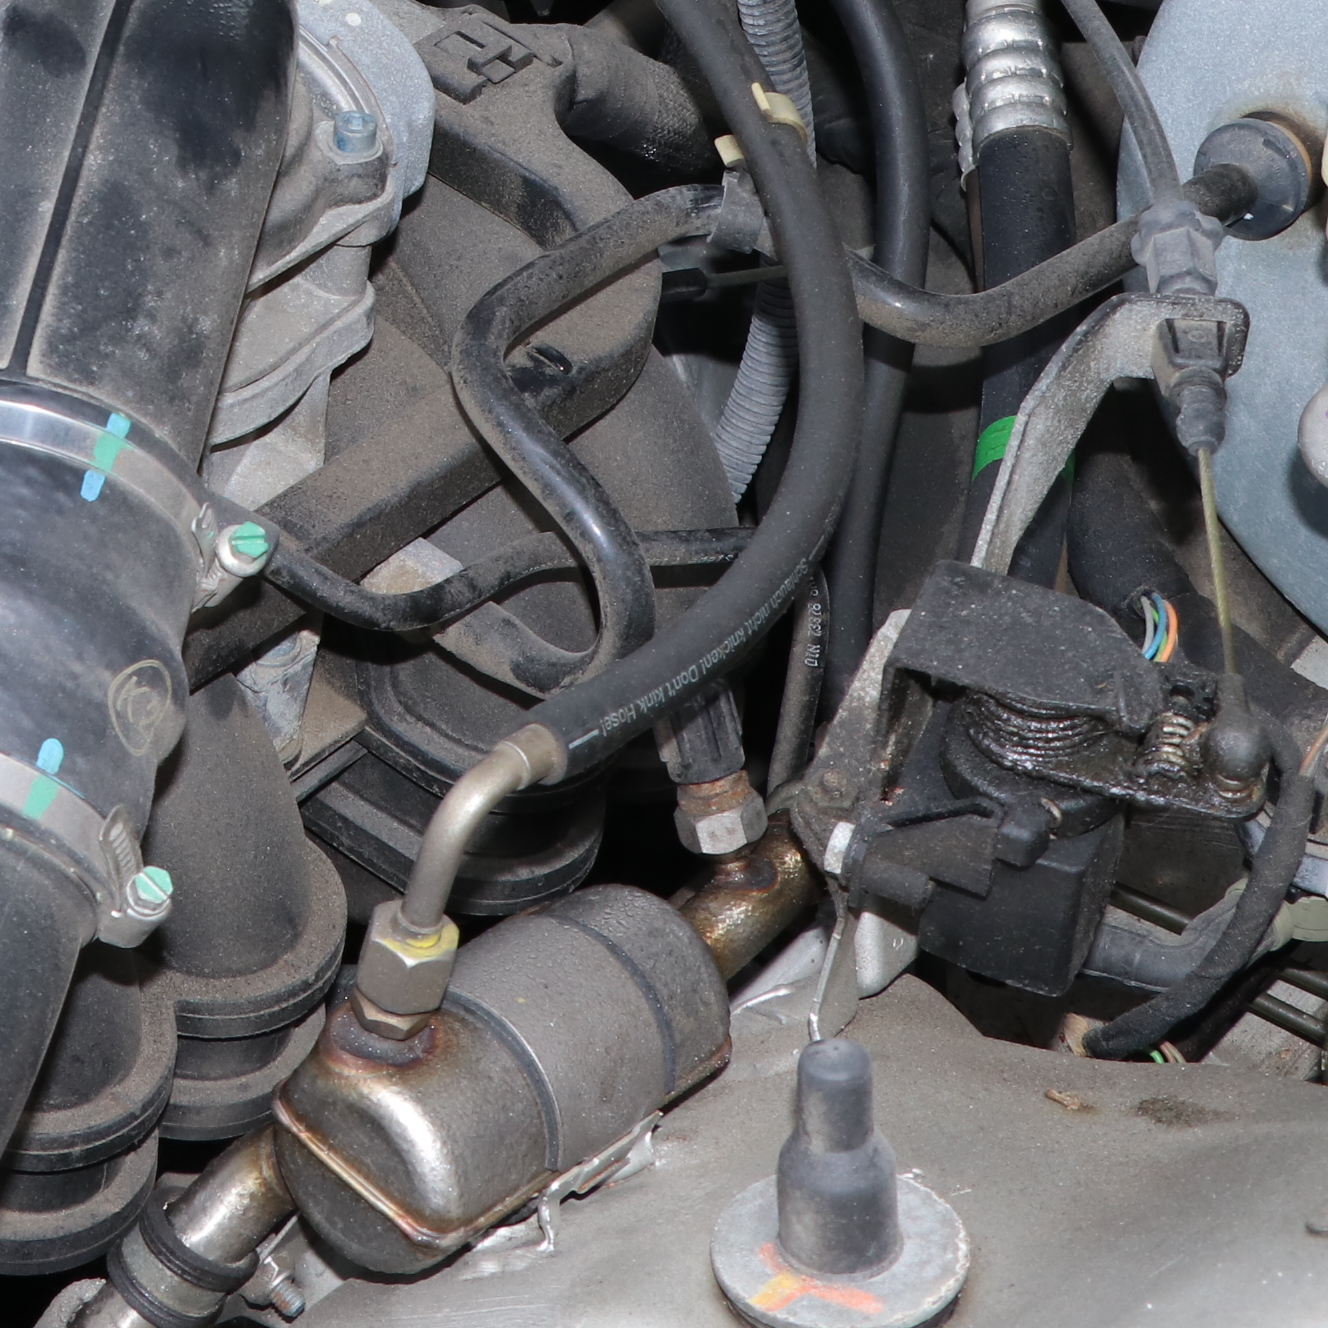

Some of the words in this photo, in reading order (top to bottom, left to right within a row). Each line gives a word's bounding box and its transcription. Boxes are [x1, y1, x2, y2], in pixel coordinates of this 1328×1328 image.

[771, 558, 809, 610] Schlauch
[745, 604, 771, 636] nicht
[699, 626, 747, 676] knicken!
[804, 643, 821, 668] DIN
[667, 664, 702, 698] Don't
[636, 683, 670, 714] kink
[601, 702, 637, 738] Hose!
